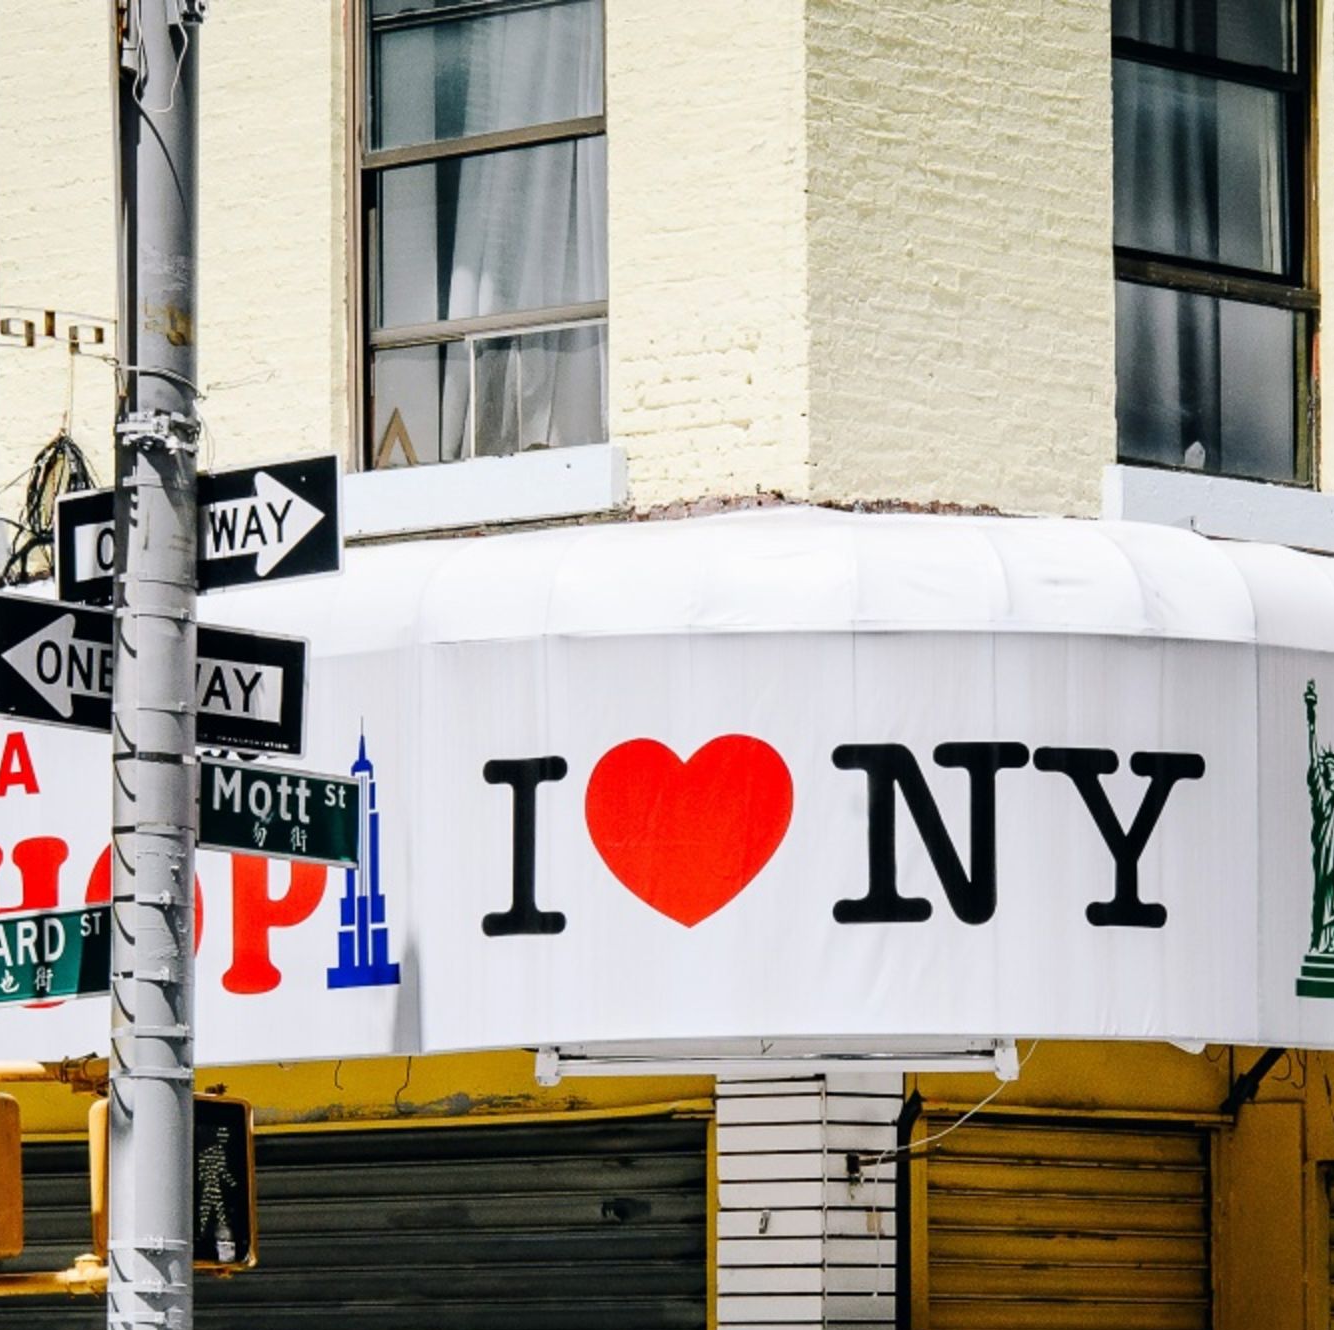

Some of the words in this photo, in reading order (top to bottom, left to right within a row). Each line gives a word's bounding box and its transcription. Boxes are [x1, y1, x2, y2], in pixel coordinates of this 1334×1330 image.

[208, 499, 293, 552] WAY
[197, 666, 262, 713] AY
[213, 767, 311, 824] Mott
[324, 783, 346, 808] St
[482, 756, 568, 936] I
[832, 742, 1205, 928] NY
[81, 912, 101, 936] ST
